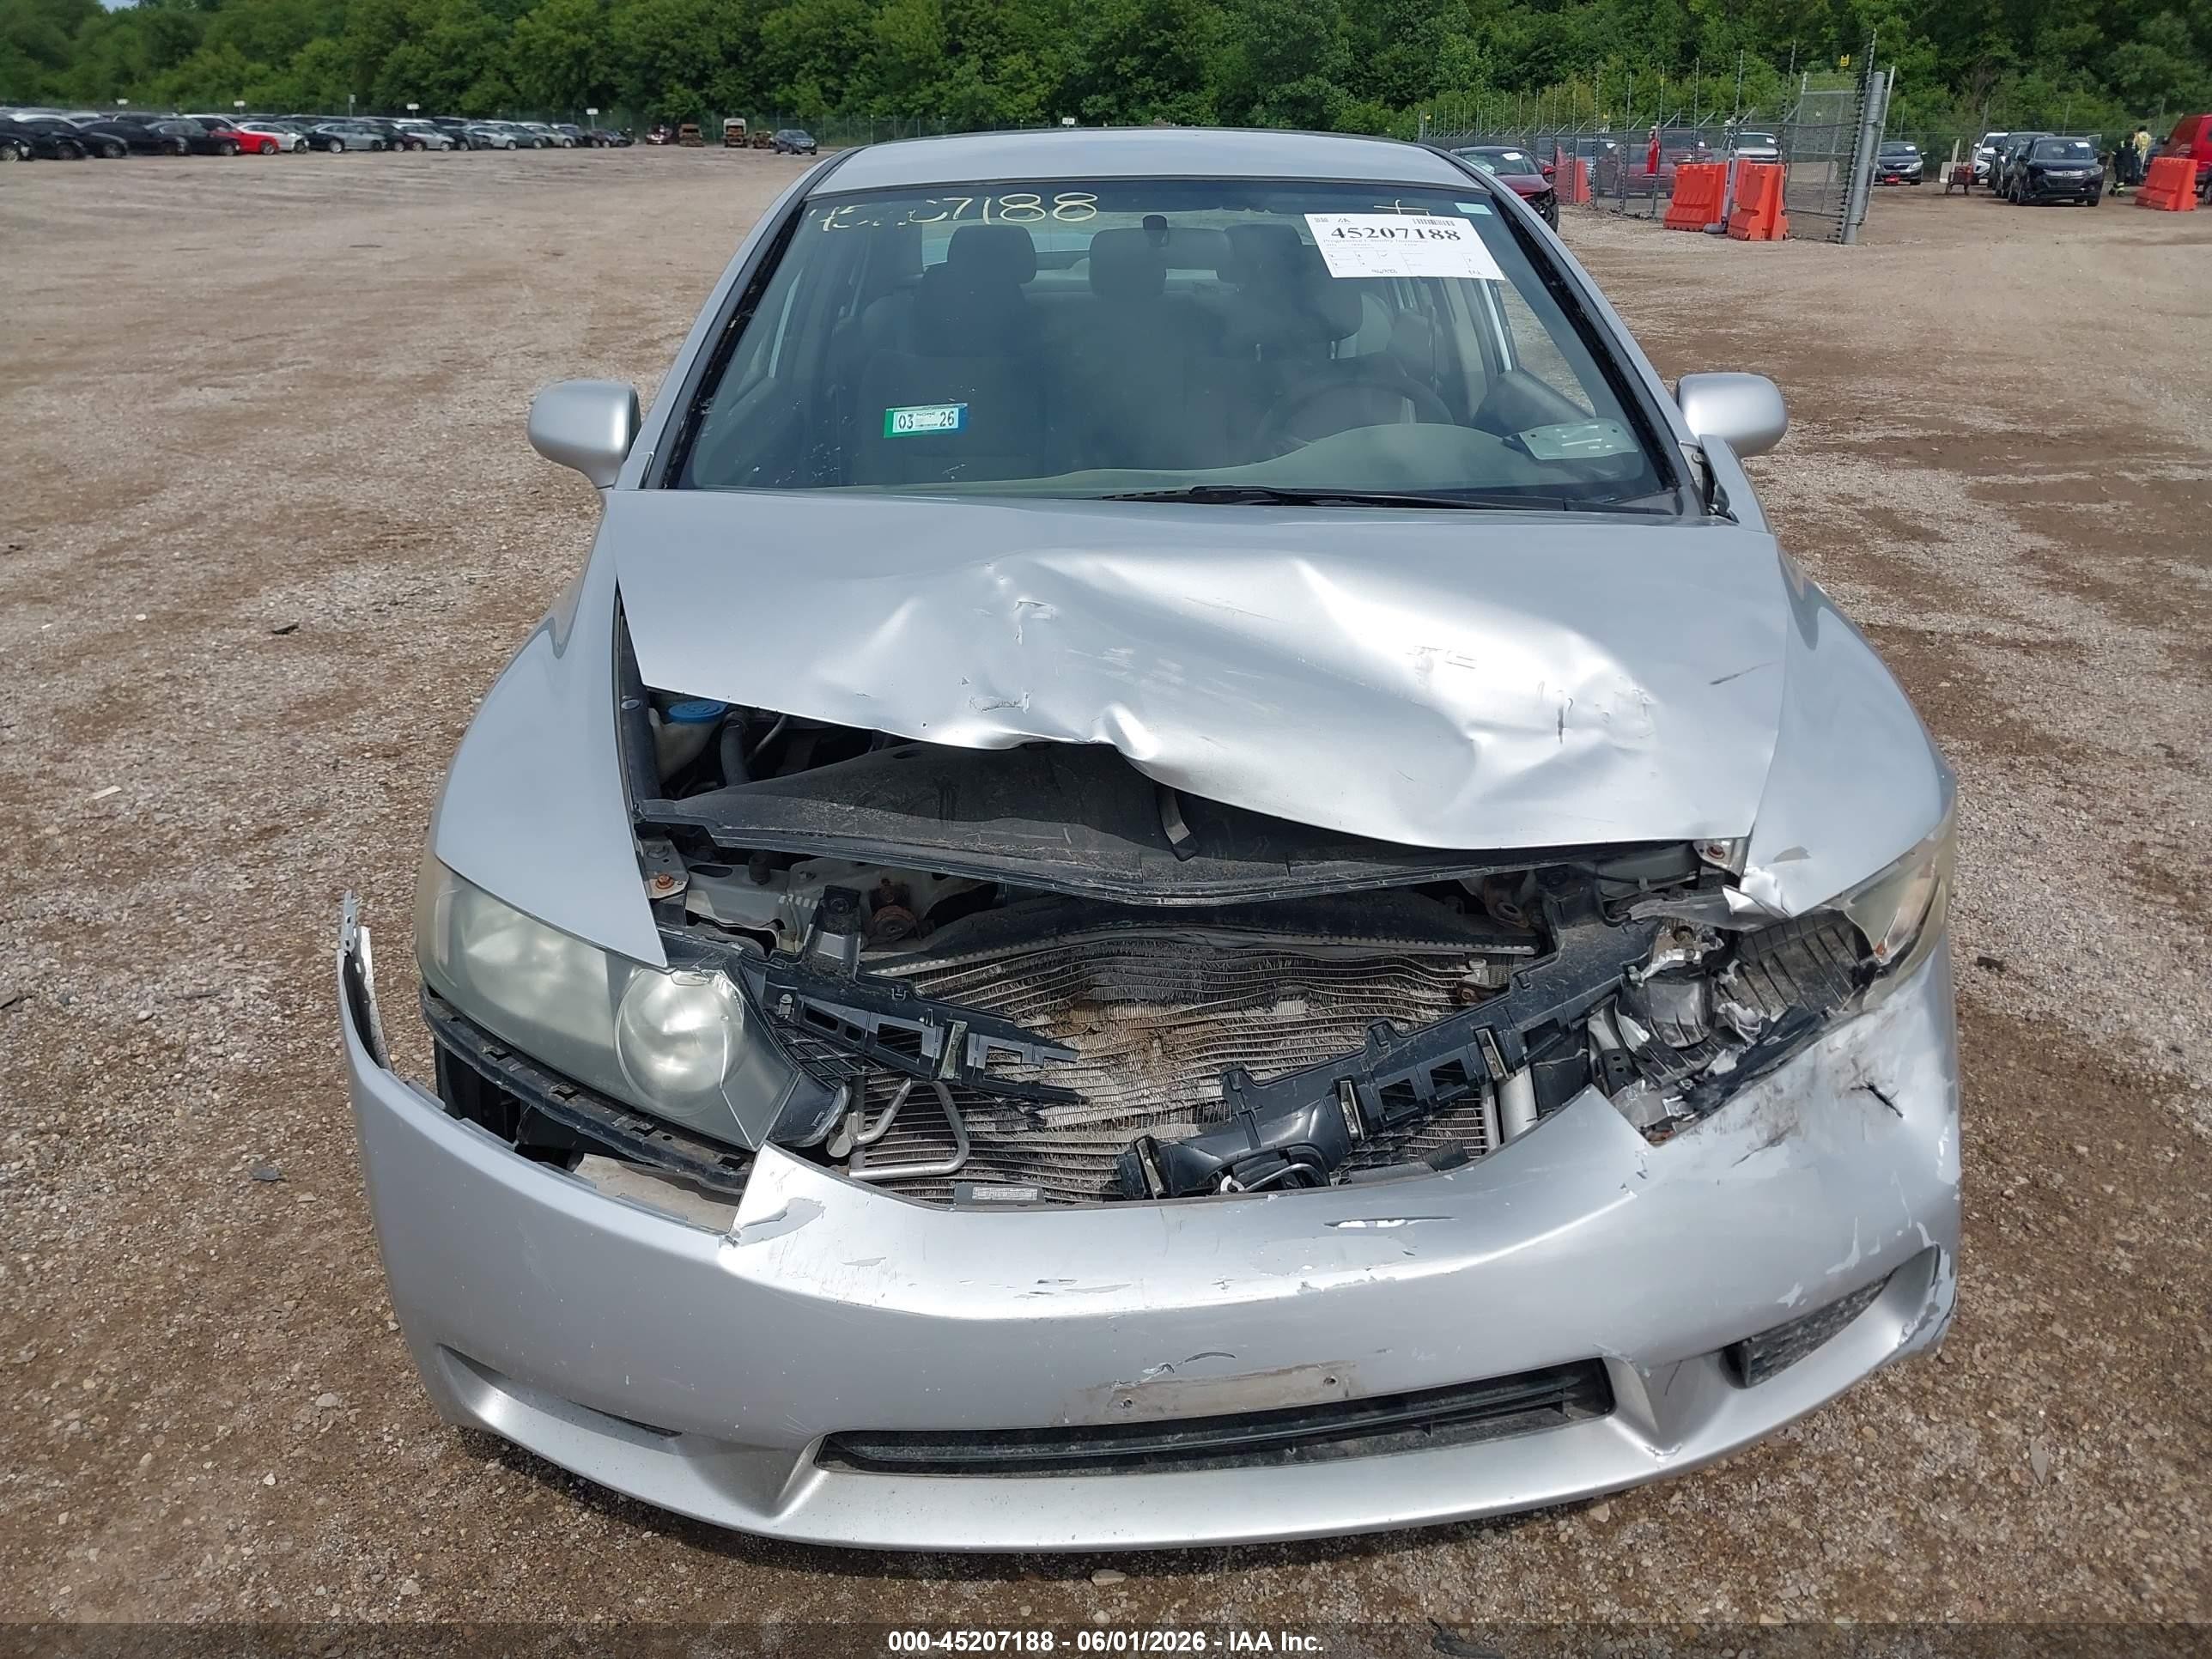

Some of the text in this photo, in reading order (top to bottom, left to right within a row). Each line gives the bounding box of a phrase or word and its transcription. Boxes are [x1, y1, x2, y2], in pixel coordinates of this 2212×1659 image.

[1331, 227, 1462, 241] 45207188
[898, 414, 914, 429] 03
[939, 410, 955, 427] 26
